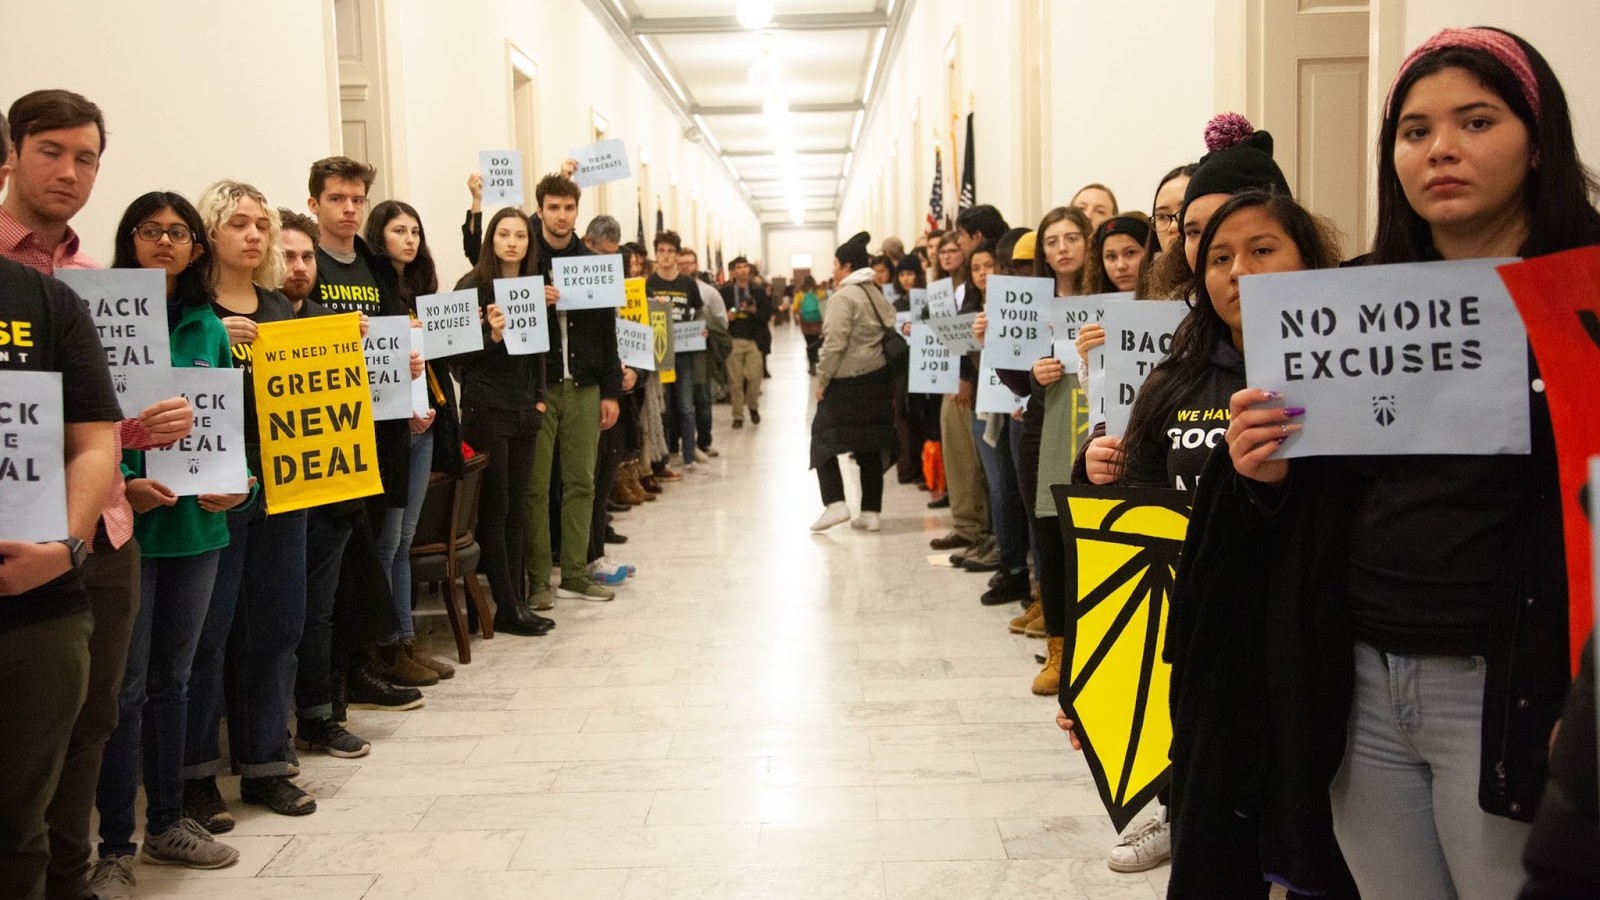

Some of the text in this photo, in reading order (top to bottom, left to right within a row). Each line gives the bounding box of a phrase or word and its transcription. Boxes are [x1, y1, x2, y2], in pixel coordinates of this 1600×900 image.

[491, 157, 509, 166] DO
[489, 168, 513, 176] YOUR
[490, 178, 514, 187] JOB
[563, 263, 614, 275] NO MORE
[564, 275, 614, 287] EXCUSES
[320, 284, 381, 303] SUNRISE
[509, 288, 530, 301] DO
[1005, 290, 1033, 305] DO
[426, 302, 470, 317] NO MORE
[507, 303, 536, 315] YOUR
[1000, 309, 1038, 322] YOUR
[508, 316, 537, 330] JOB
[1066, 310, 1088, 323] NO
[1281, 296, 1480, 339] NO MORE
[96, 324, 136, 338] THE
[428, 316, 470, 332] EXCUSES
[952, 321, 973, 330] MOR
[0, 321, 34, 347] SE
[943, 331, 973, 341] EXCUS
[999, 325, 1037, 340] JOB
[364, 336, 400, 351] ACK
[619, 338, 647, 351] CUSES
[1121, 329, 1173, 355] BAC
[104, 345, 155, 367] EAL
[265, 341, 359, 362] WE NEED THE
[921, 348, 950, 358] YOUR
[364, 355, 390, 366] THE
[920, 361, 949, 371] JOB
[1284, 339, 1483, 381] EXCUSES
[267, 366, 362, 398] GREEN
[367, 370, 401, 384] EAL
[181, 393, 225, 410] CK
[0, 402, 39, 425] CK
[1177, 408, 1232, 422] WE HAV
[193, 416, 211, 428] HE
[269, 401, 362, 441] NEW
[160, 435, 227, 452] EAL
[1167, 427, 1227, 450] GOO
[0, 457, 40, 482] AL
[273, 443, 368, 486] DEAL
